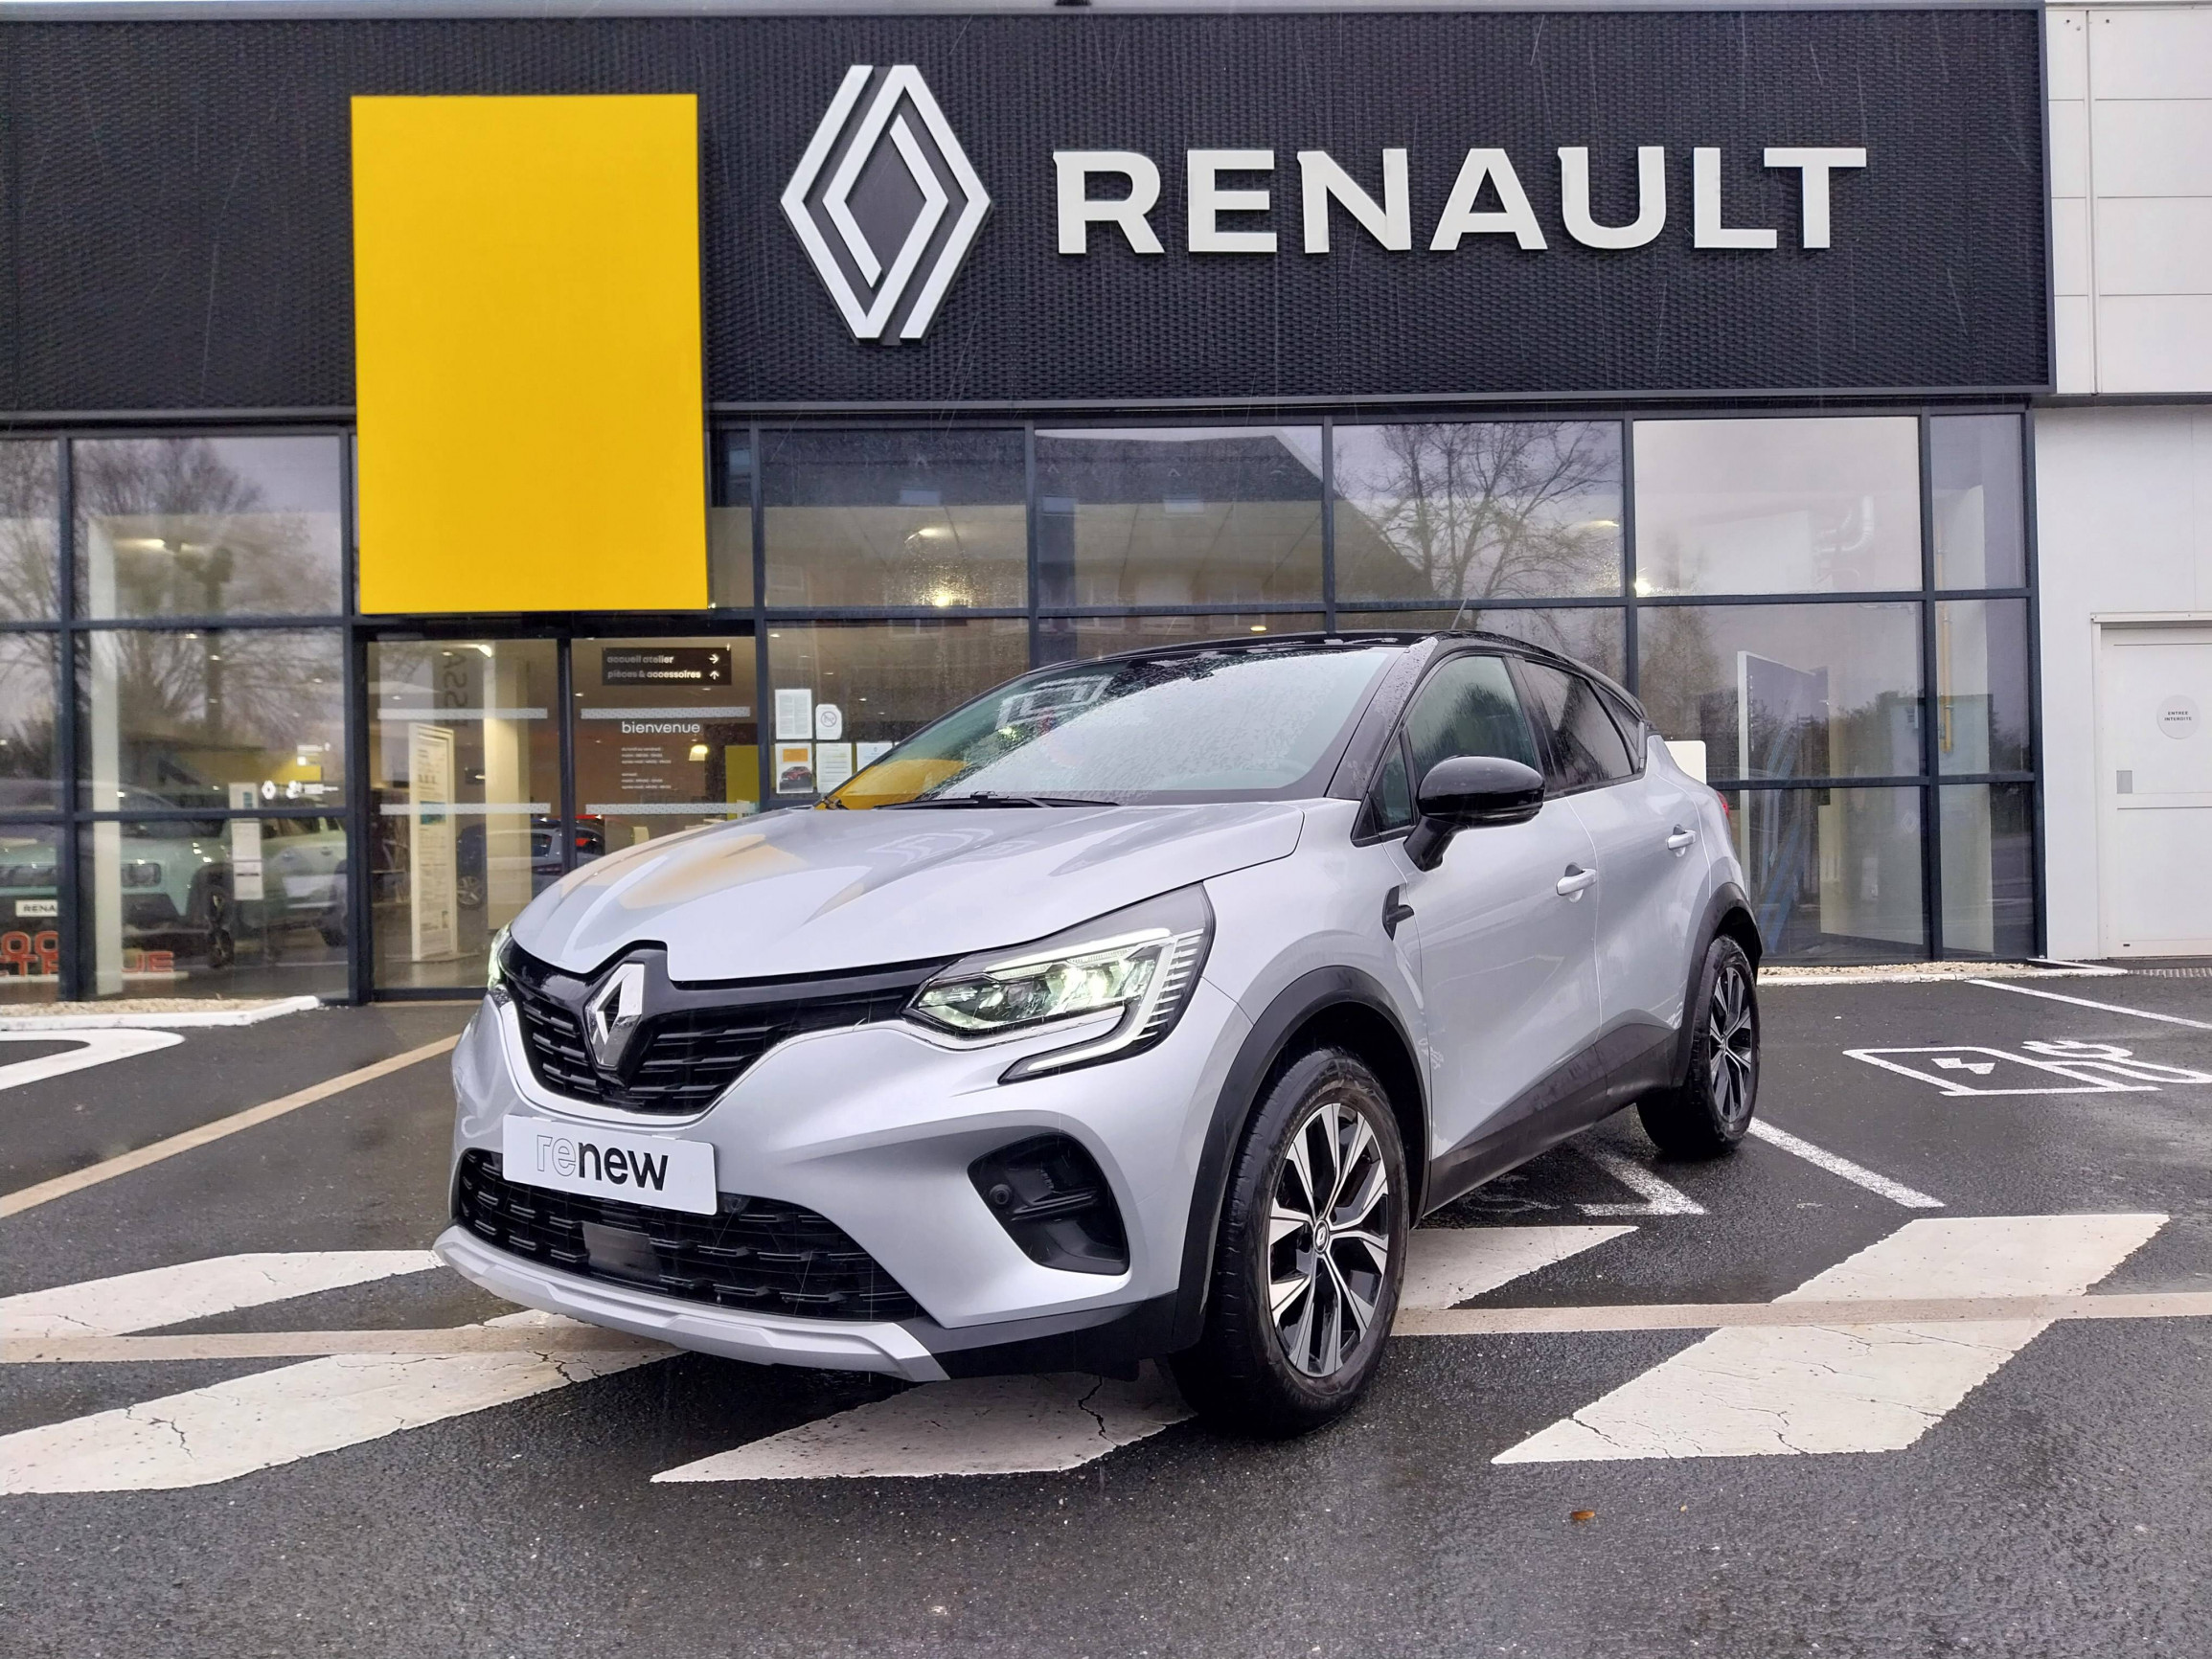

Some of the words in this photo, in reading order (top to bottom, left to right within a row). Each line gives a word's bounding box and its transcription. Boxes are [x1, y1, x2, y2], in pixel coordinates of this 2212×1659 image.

[1053, 146, 1868, 256] RENAULT
[606, 654, 642, 664] accueil
[643, 654, 674, 664] atelier
[638, 670, 646, 678] &
[647, 670, 701, 679] accessoires
[621, 720, 700, 734] bienvenue
[536, 1134, 669, 1192] renew
